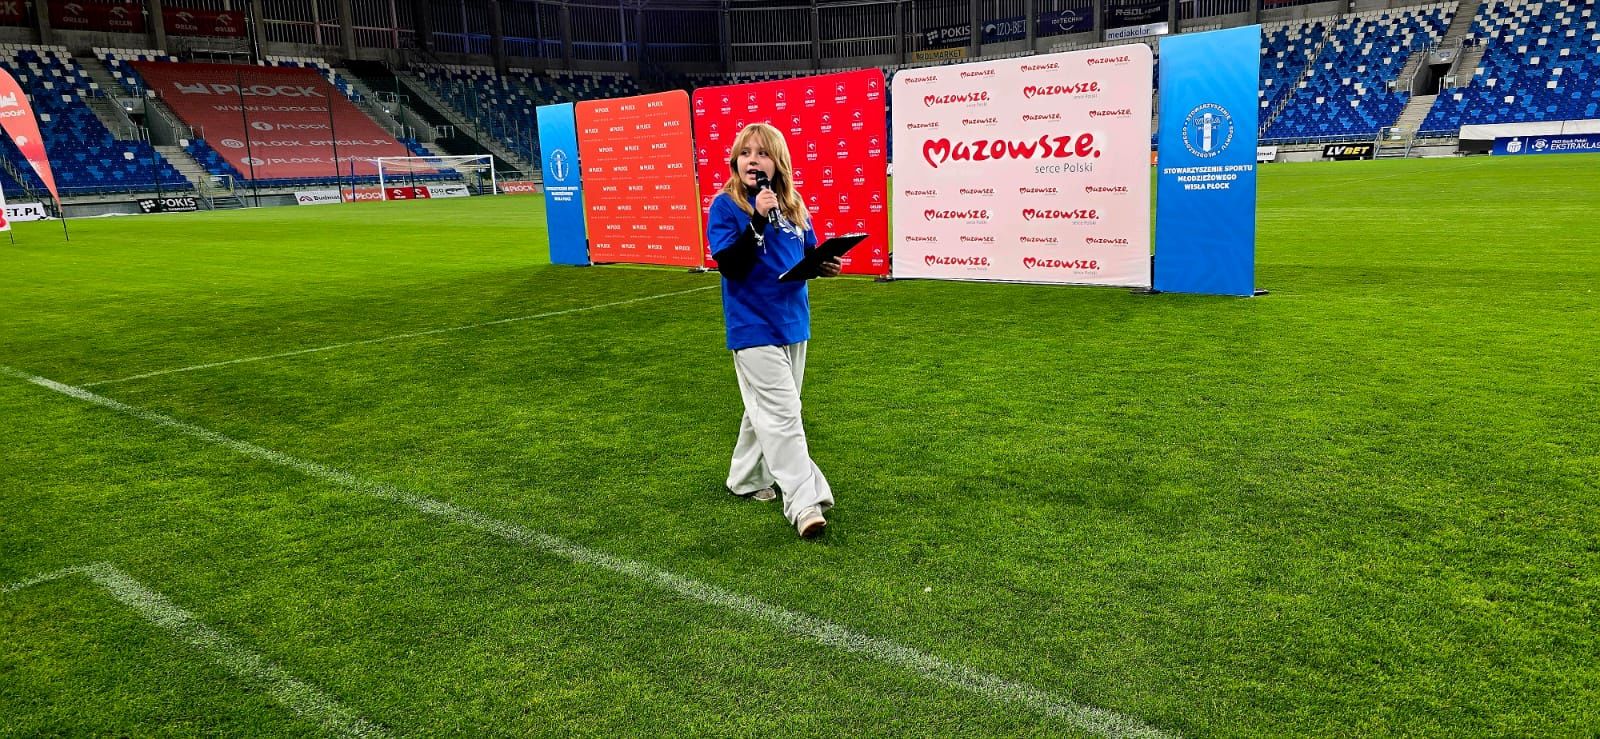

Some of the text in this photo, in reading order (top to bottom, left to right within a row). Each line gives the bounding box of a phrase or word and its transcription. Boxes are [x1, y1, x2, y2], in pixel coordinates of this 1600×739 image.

[941, 25, 970, 38] POKIS
[996, 20, 1026, 36] IZO-BET
[1108, 28, 1150, 39] mediakolor
[1024, 82, 1100, 99] Mazowsze.
[924, 91, 990, 107] Mazowsze.
[922, 132, 1101, 168] Mazowsze.
[1326, 146, 1370, 156] LVBET
[1034, 162, 1093, 174] serce Polski
[1164, 166, 1223, 174] STOWARZYSZENIE
[1178, 174, 1237, 182] MŁODZIEŻOWEGO
[158, 198, 196, 206] POKIS
[924, 209, 990, 221] Mazowsze.
[1022, 209, 1099, 221] Mazowsze.
[925, 255, 990, 266] Mazowsze.
[1024, 257, 1100, 269] Mazowsze.
